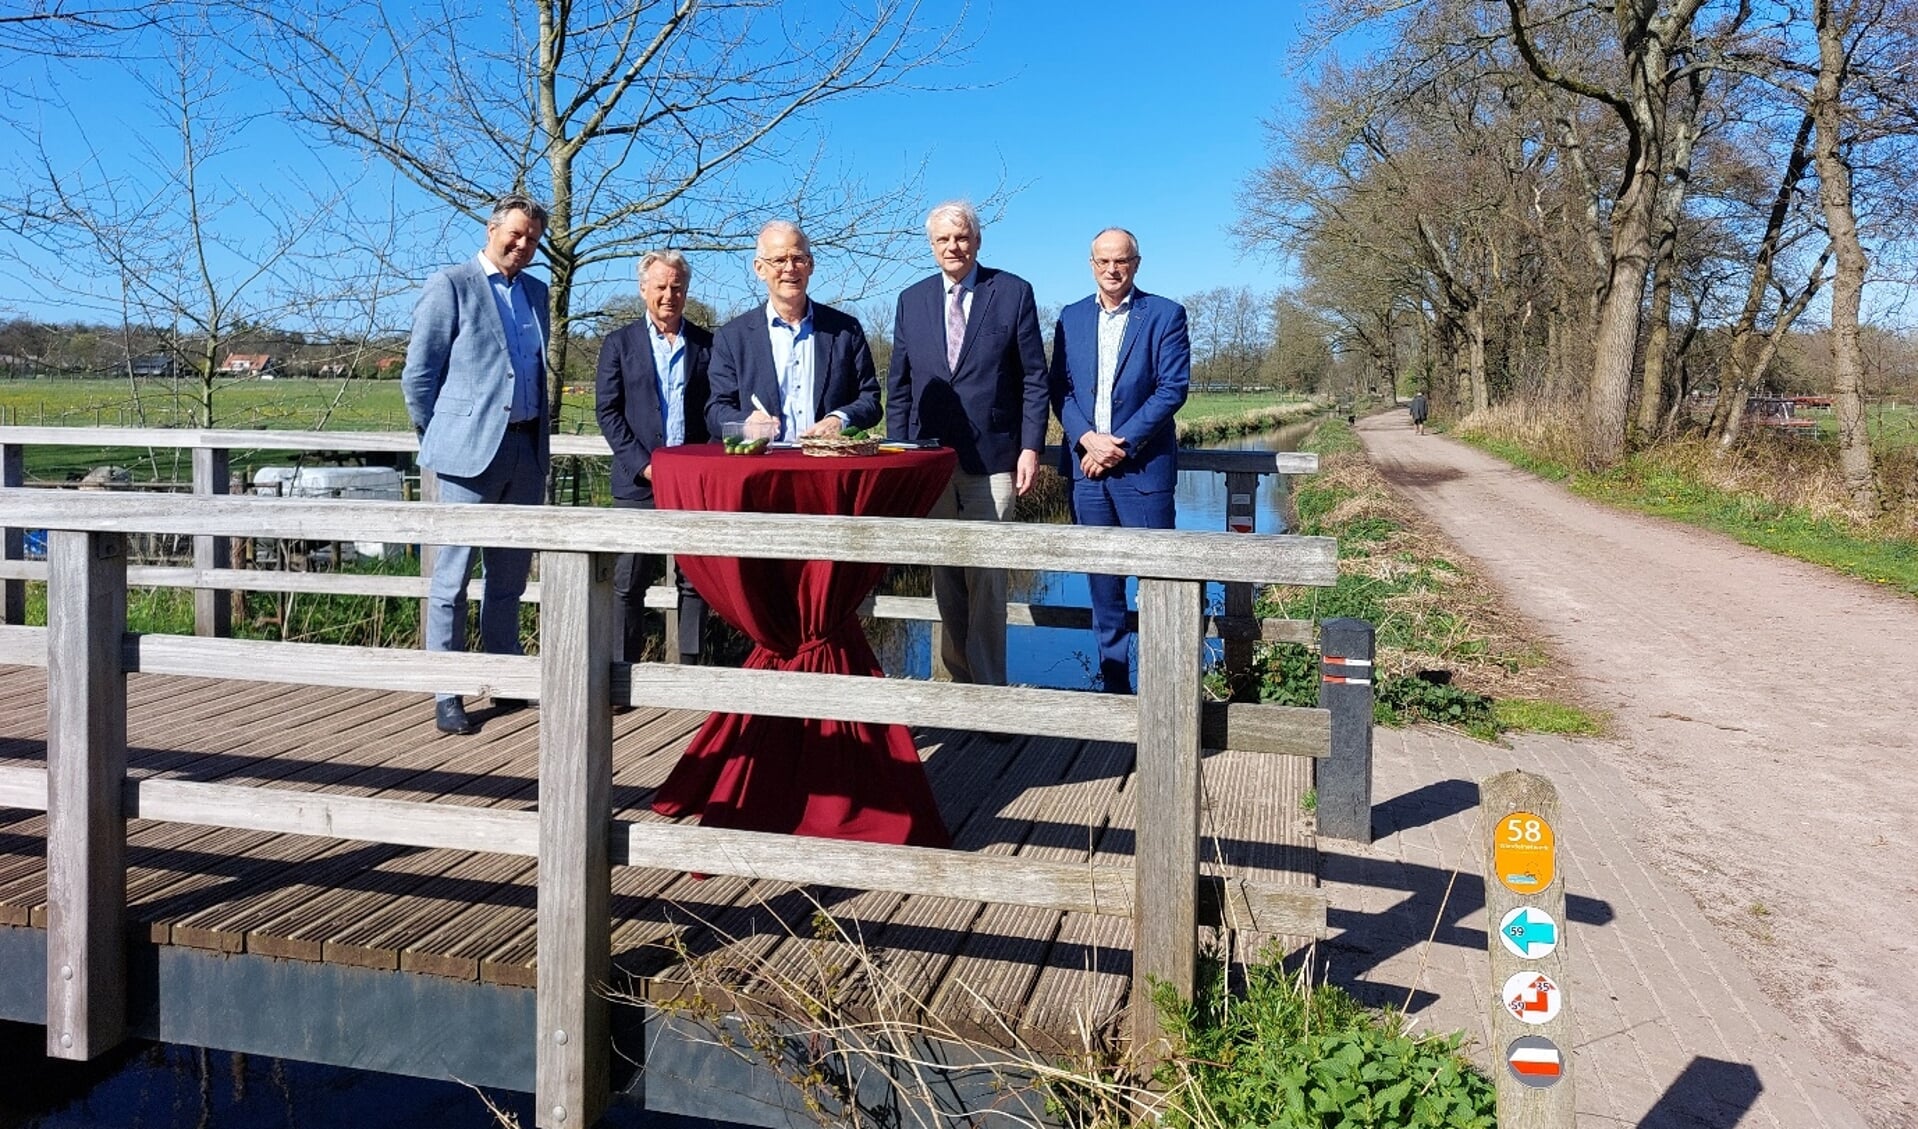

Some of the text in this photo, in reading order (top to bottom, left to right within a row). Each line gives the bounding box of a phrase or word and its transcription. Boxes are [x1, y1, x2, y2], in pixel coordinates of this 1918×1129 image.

[1507, 819, 1541, 842] 58
[1511, 926, 1524, 937] 59
[1537, 982, 1550, 992] 35
[1511, 1000, 1525, 1010] 59
